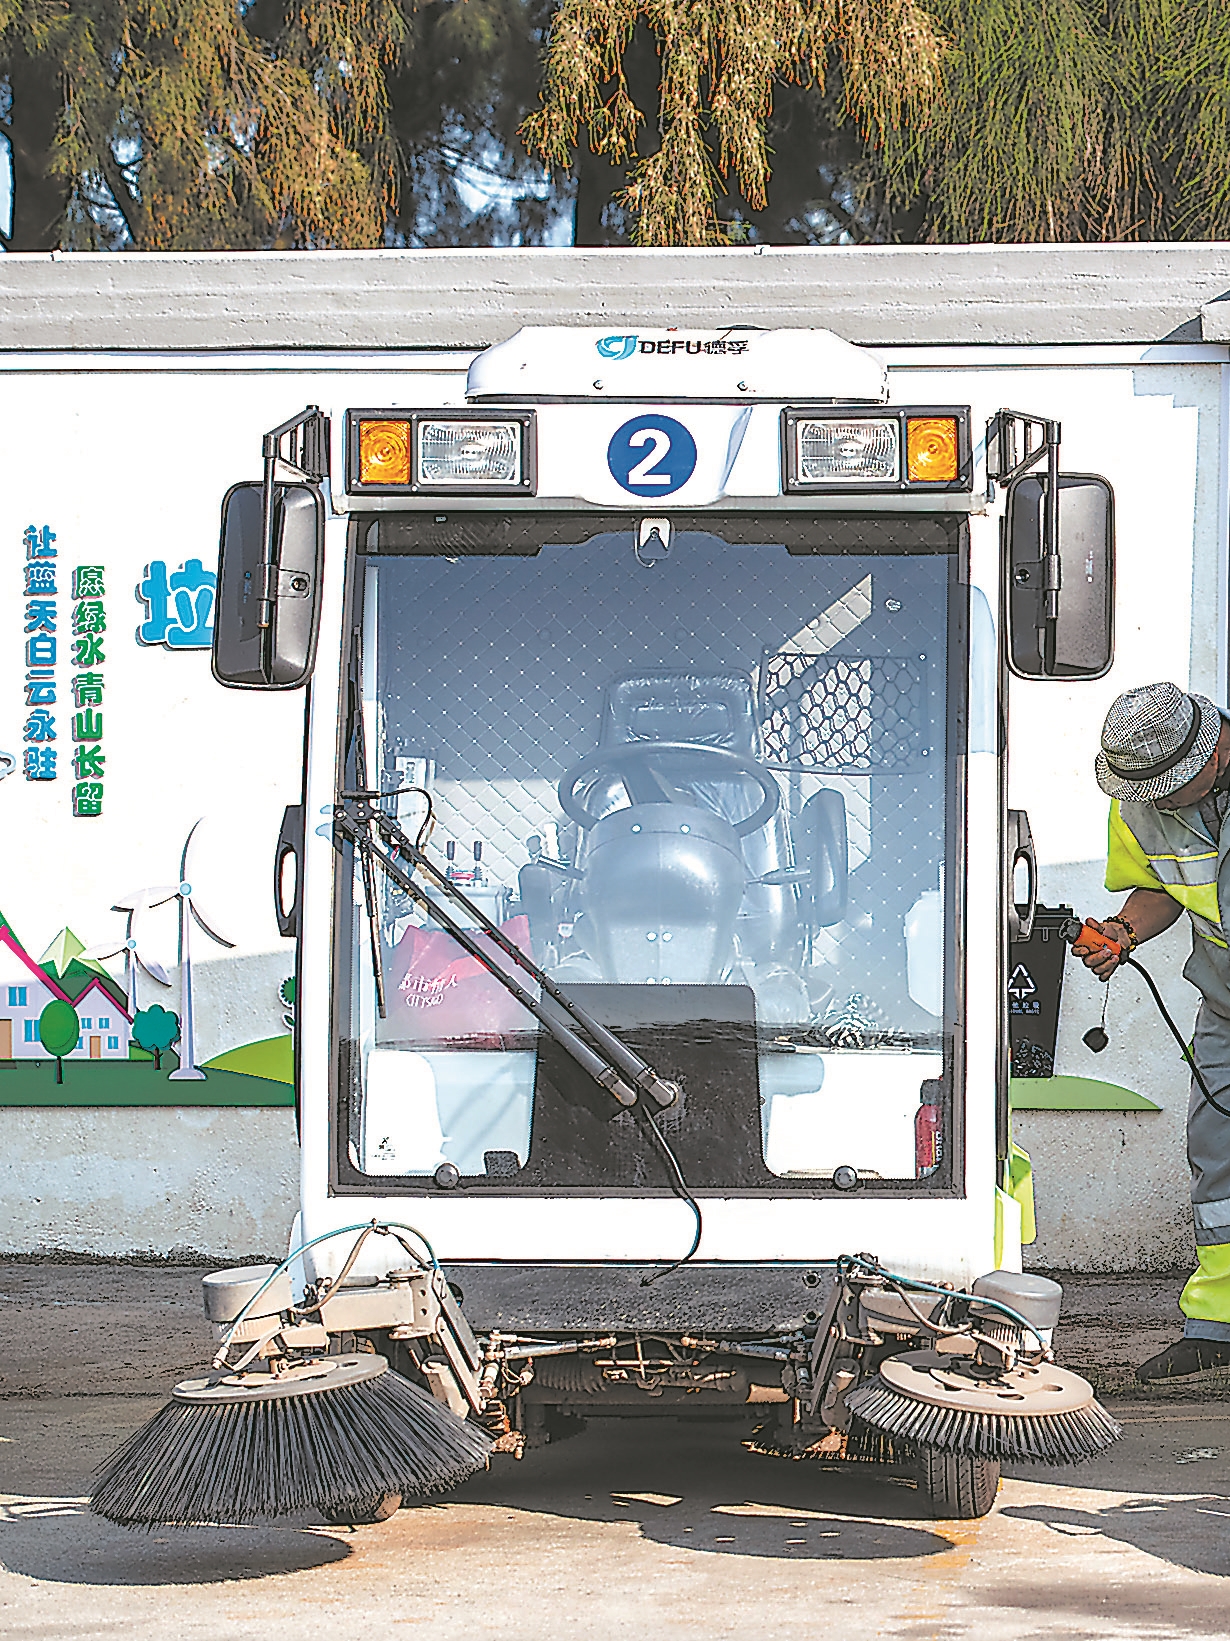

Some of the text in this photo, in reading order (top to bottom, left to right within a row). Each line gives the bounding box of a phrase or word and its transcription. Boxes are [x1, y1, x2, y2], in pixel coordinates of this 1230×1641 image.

[639, 340, 701, 354] DEFU
[627, 428, 672, 486] 2
[25, 524, 57, 780] 让蓝天白云永驻
[74, 565, 106, 816] 愿绿水青山长留
